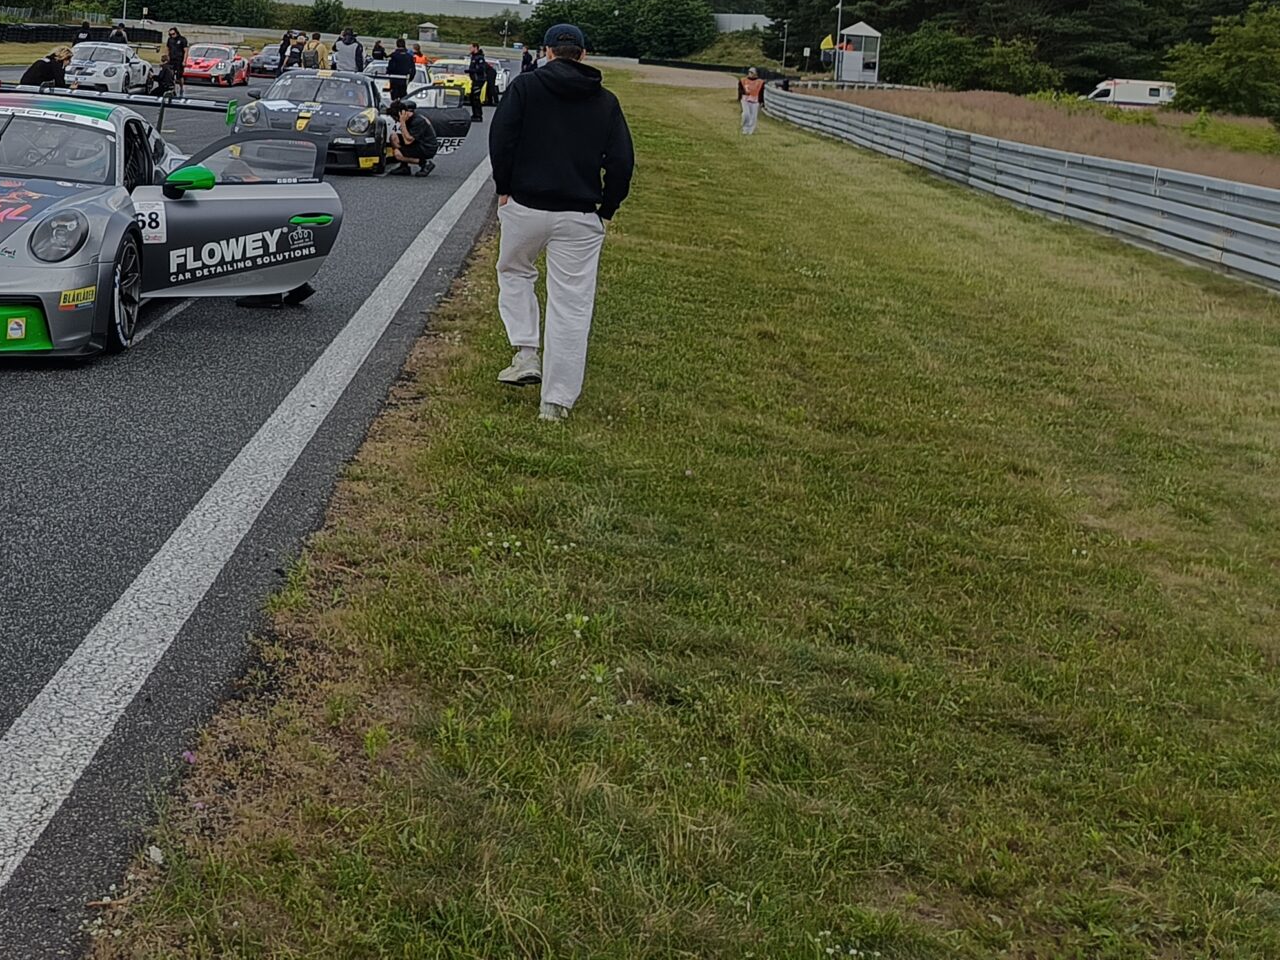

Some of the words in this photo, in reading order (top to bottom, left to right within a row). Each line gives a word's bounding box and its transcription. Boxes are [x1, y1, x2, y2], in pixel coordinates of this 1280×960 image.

[135, 211, 160, 230] 68
[170, 227, 282, 273] FLOWEY
[170, 271, 192, 282] CAR
[195, 259, 253, 278] DETAILING
[256, 246, 317, 266] SOLUTIONS
